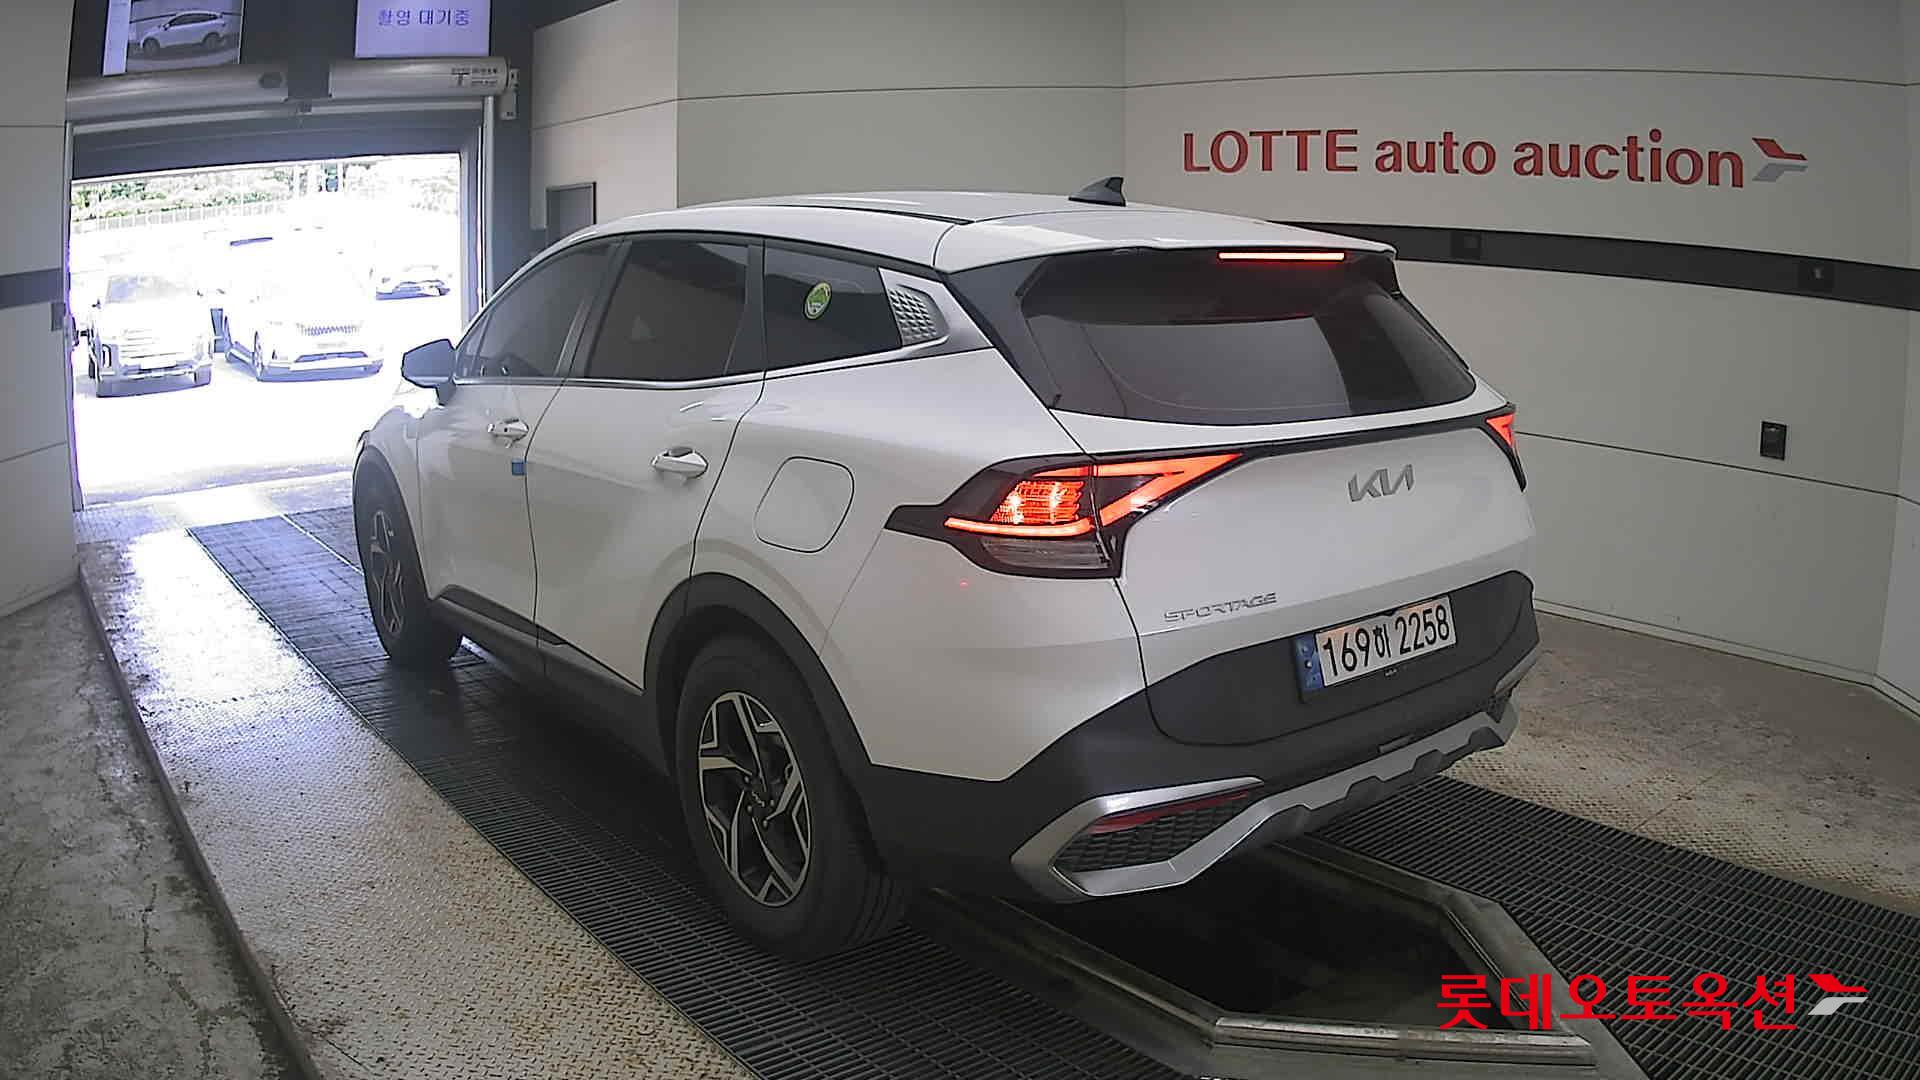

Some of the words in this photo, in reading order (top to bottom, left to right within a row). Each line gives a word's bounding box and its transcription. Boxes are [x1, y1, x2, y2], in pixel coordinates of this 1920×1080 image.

[419, 8, 470, 26] 대기중
[1183, 129, 1358, 173] LOTTE
[1375, 131, 1496, 175] auto
[1513, 129, 1744, 188] auction
[1164, 592, 1277, 622] SPORTAGE
[1395, 604, 1450, 656] 2258
